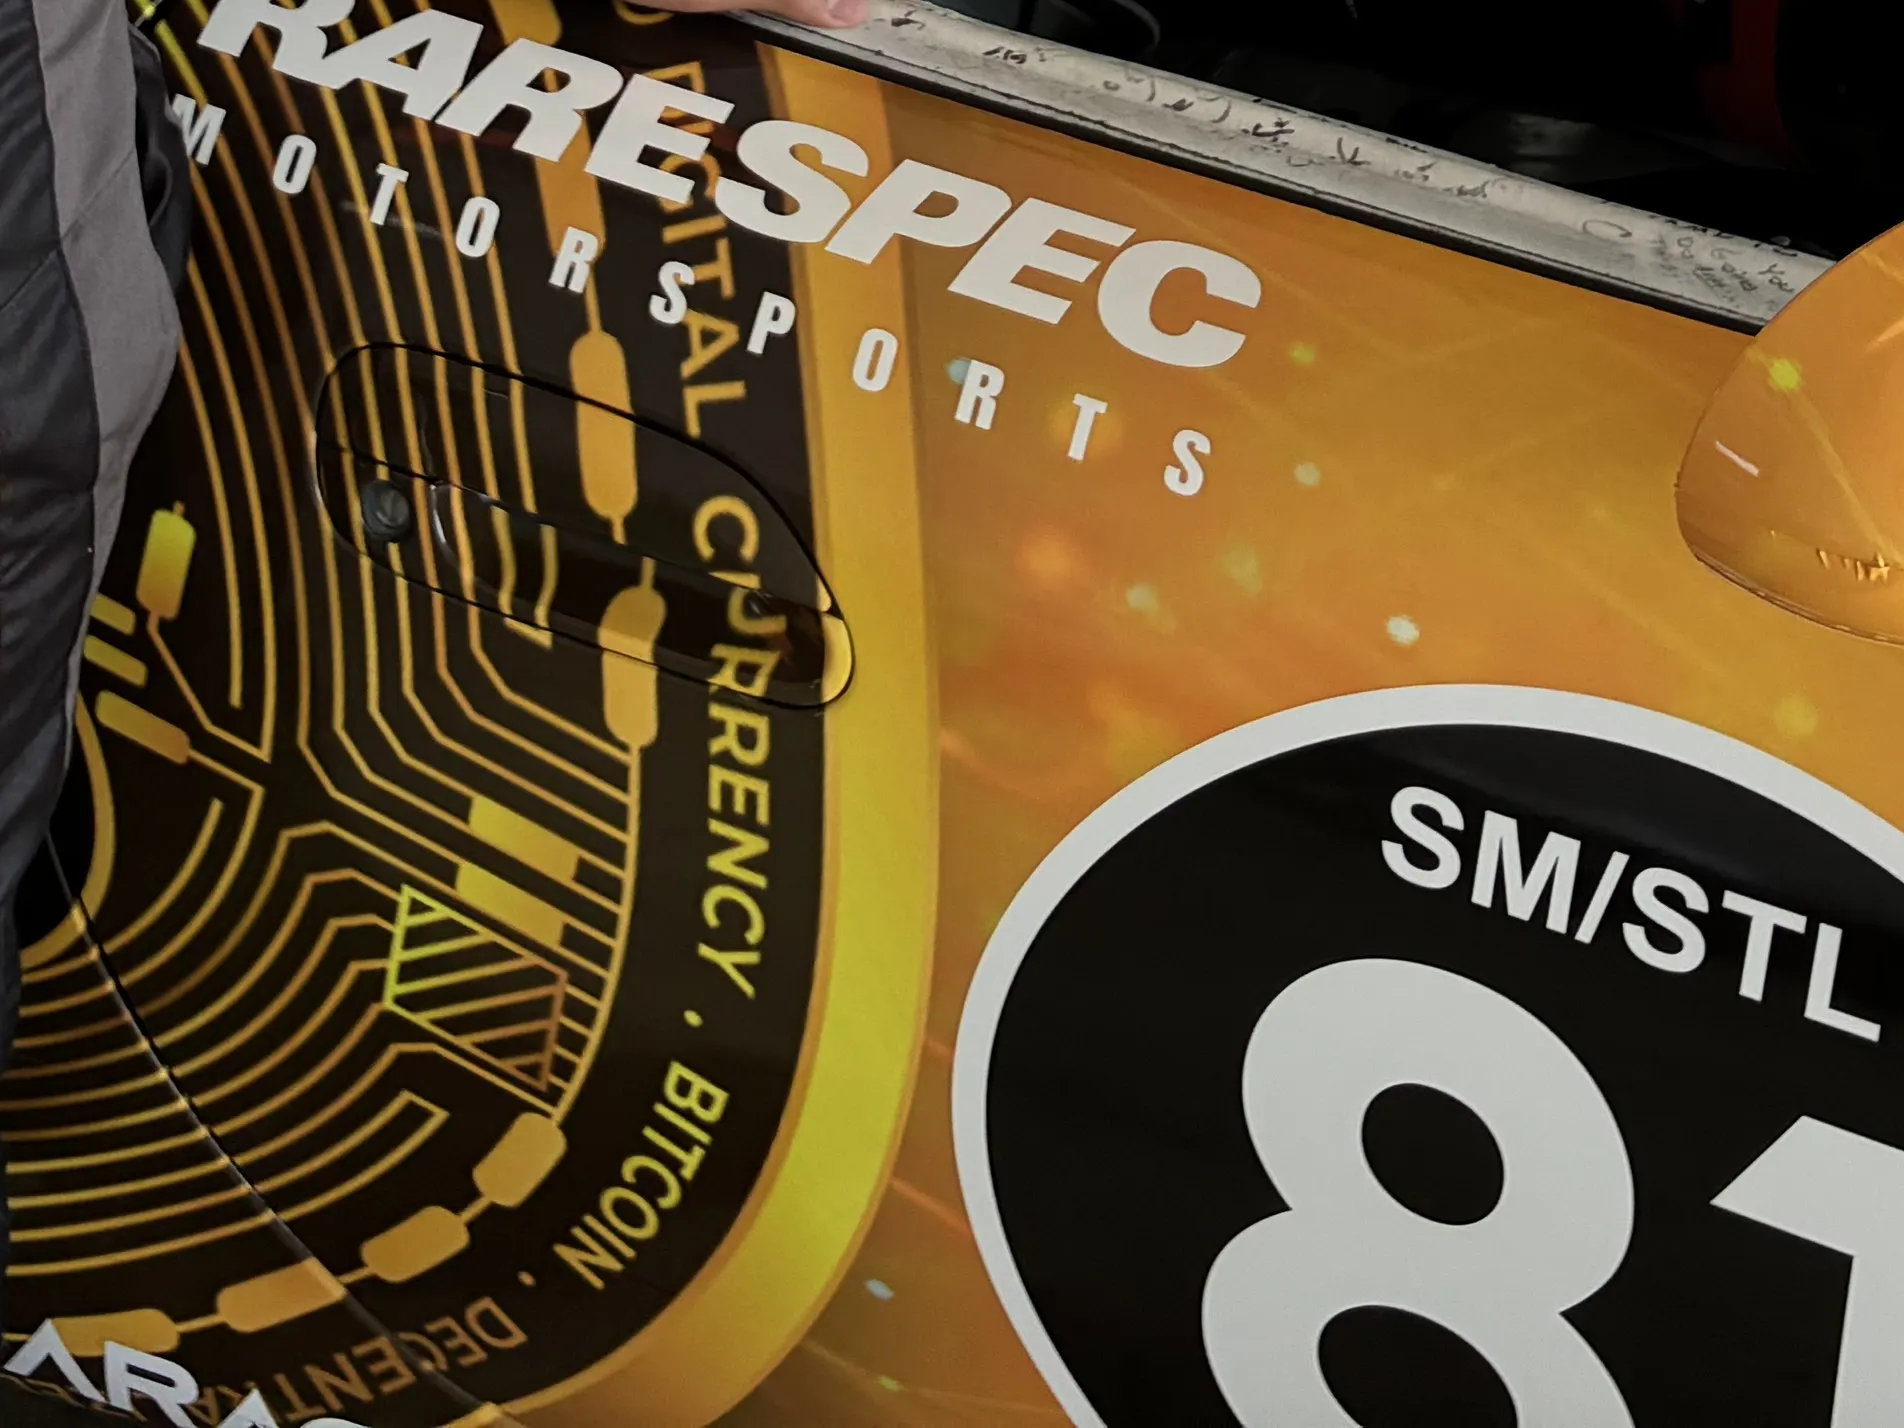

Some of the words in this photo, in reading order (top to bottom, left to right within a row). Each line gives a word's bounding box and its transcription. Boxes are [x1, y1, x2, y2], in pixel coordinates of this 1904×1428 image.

[691, 494, 773, 1001] CURRENCY
[1380, 784, 1883, 1044] SM/STL
[553, 1059, 728, 1291] BITCOIN
